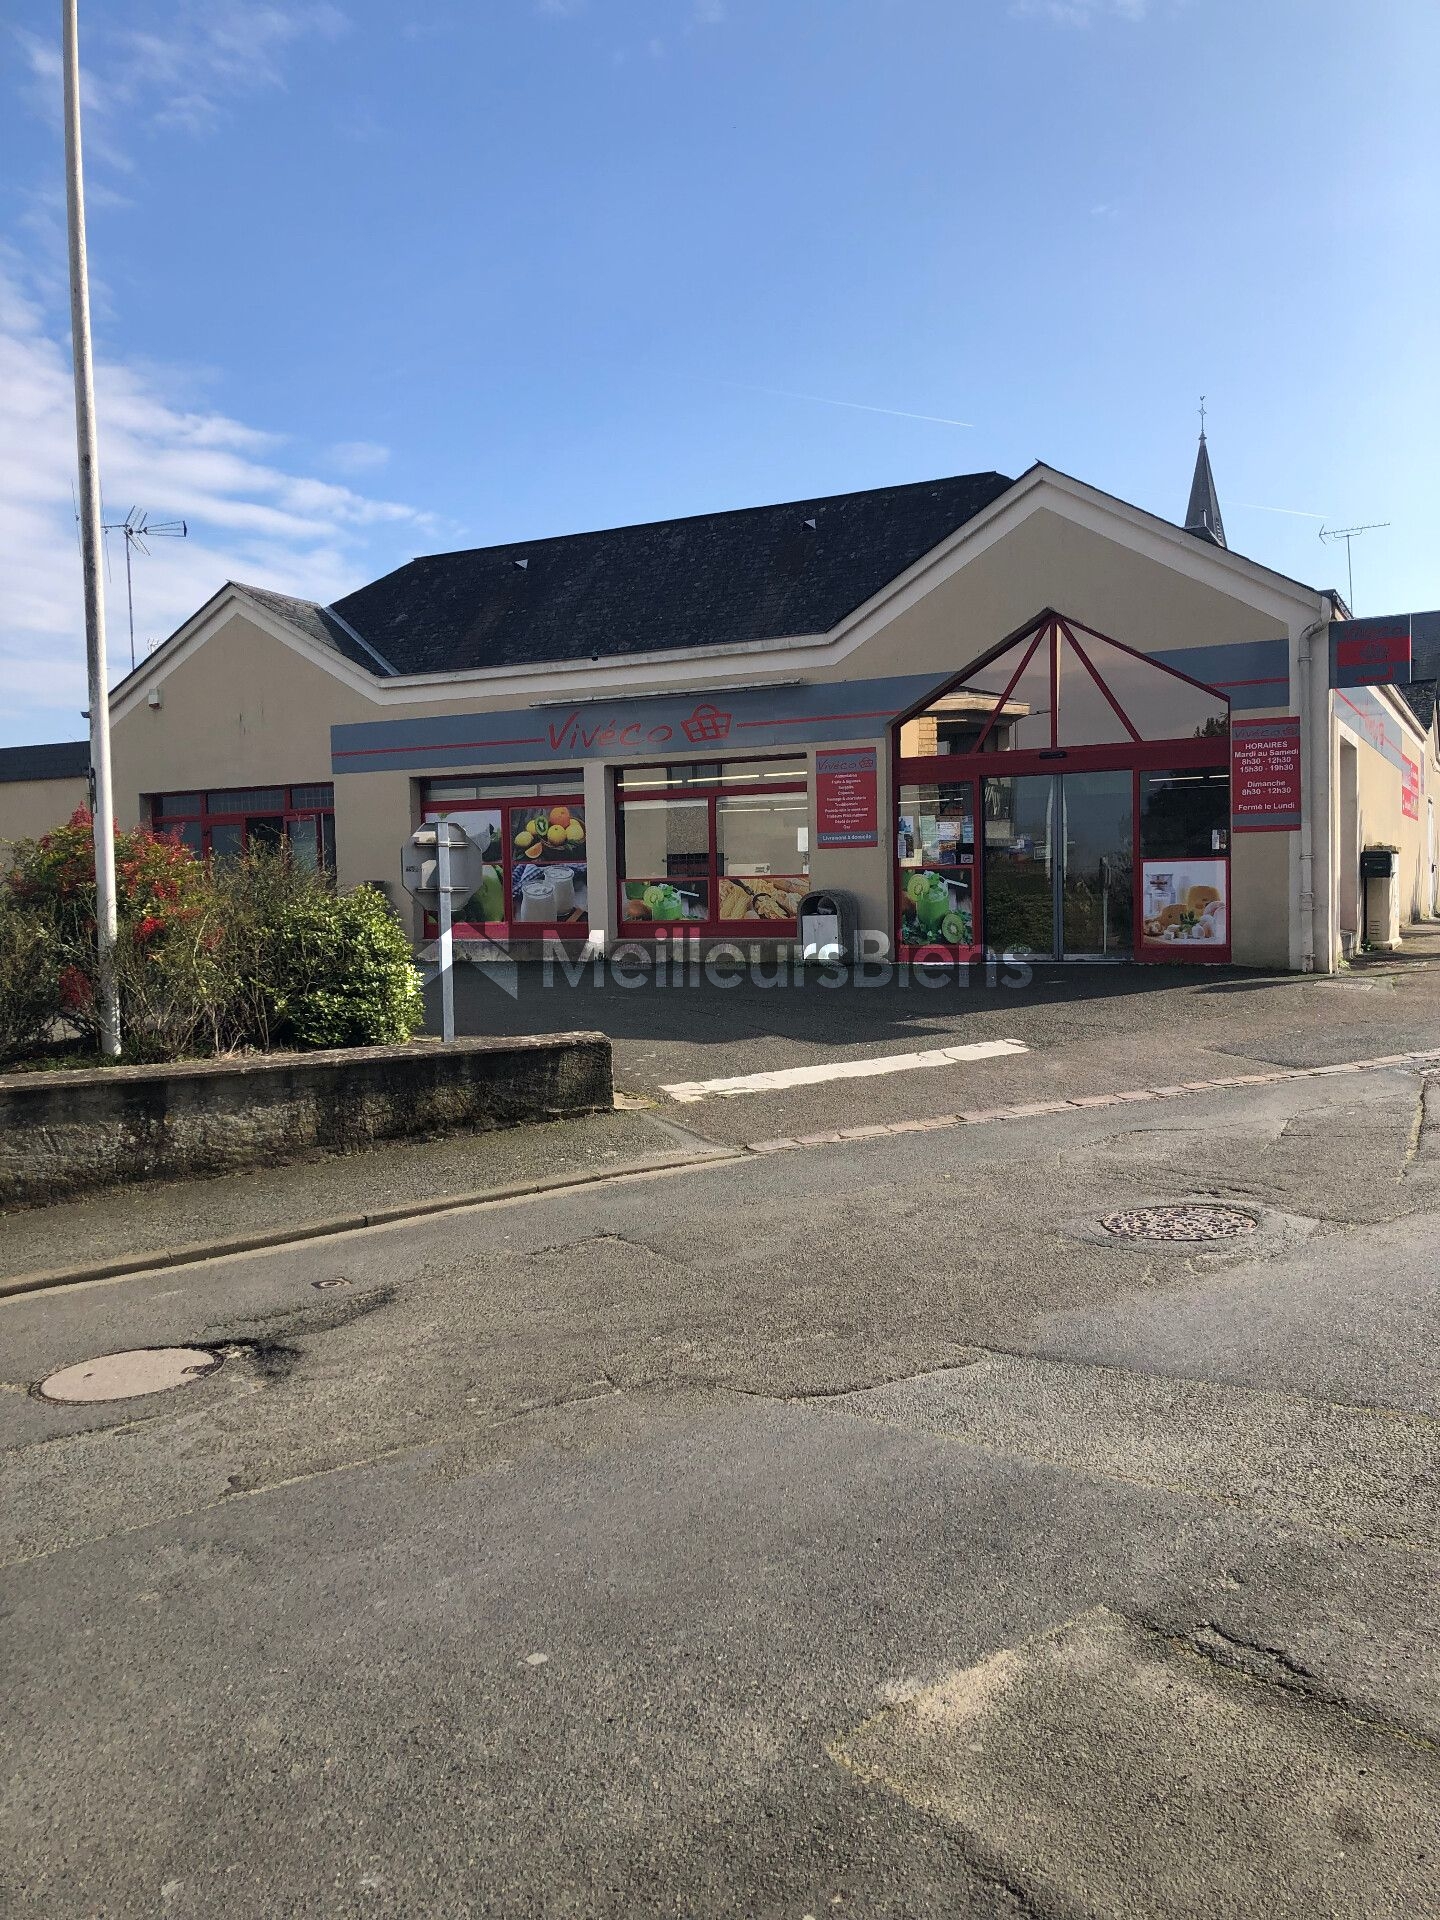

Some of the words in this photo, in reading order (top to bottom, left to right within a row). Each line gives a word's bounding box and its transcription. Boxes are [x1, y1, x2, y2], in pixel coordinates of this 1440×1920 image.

[549, 709, 674, 750] Vivéco
[1245, 741, 1288, 750] HORAIRES
[1269, 748, 1299, 756] Samedi
[1241, 757, 1261, 765] 8h30
[1267, 756, 1291, 764] 12h30
[1240, 765, 1263, 773] 15h30
[1270, 763, 1294, 771] 19h30
[1247, 780, 1286, 788] Dimanche
[1241, 788, 1261, 796] 8h30
[1267, 786, 1292, 794] 12h30
